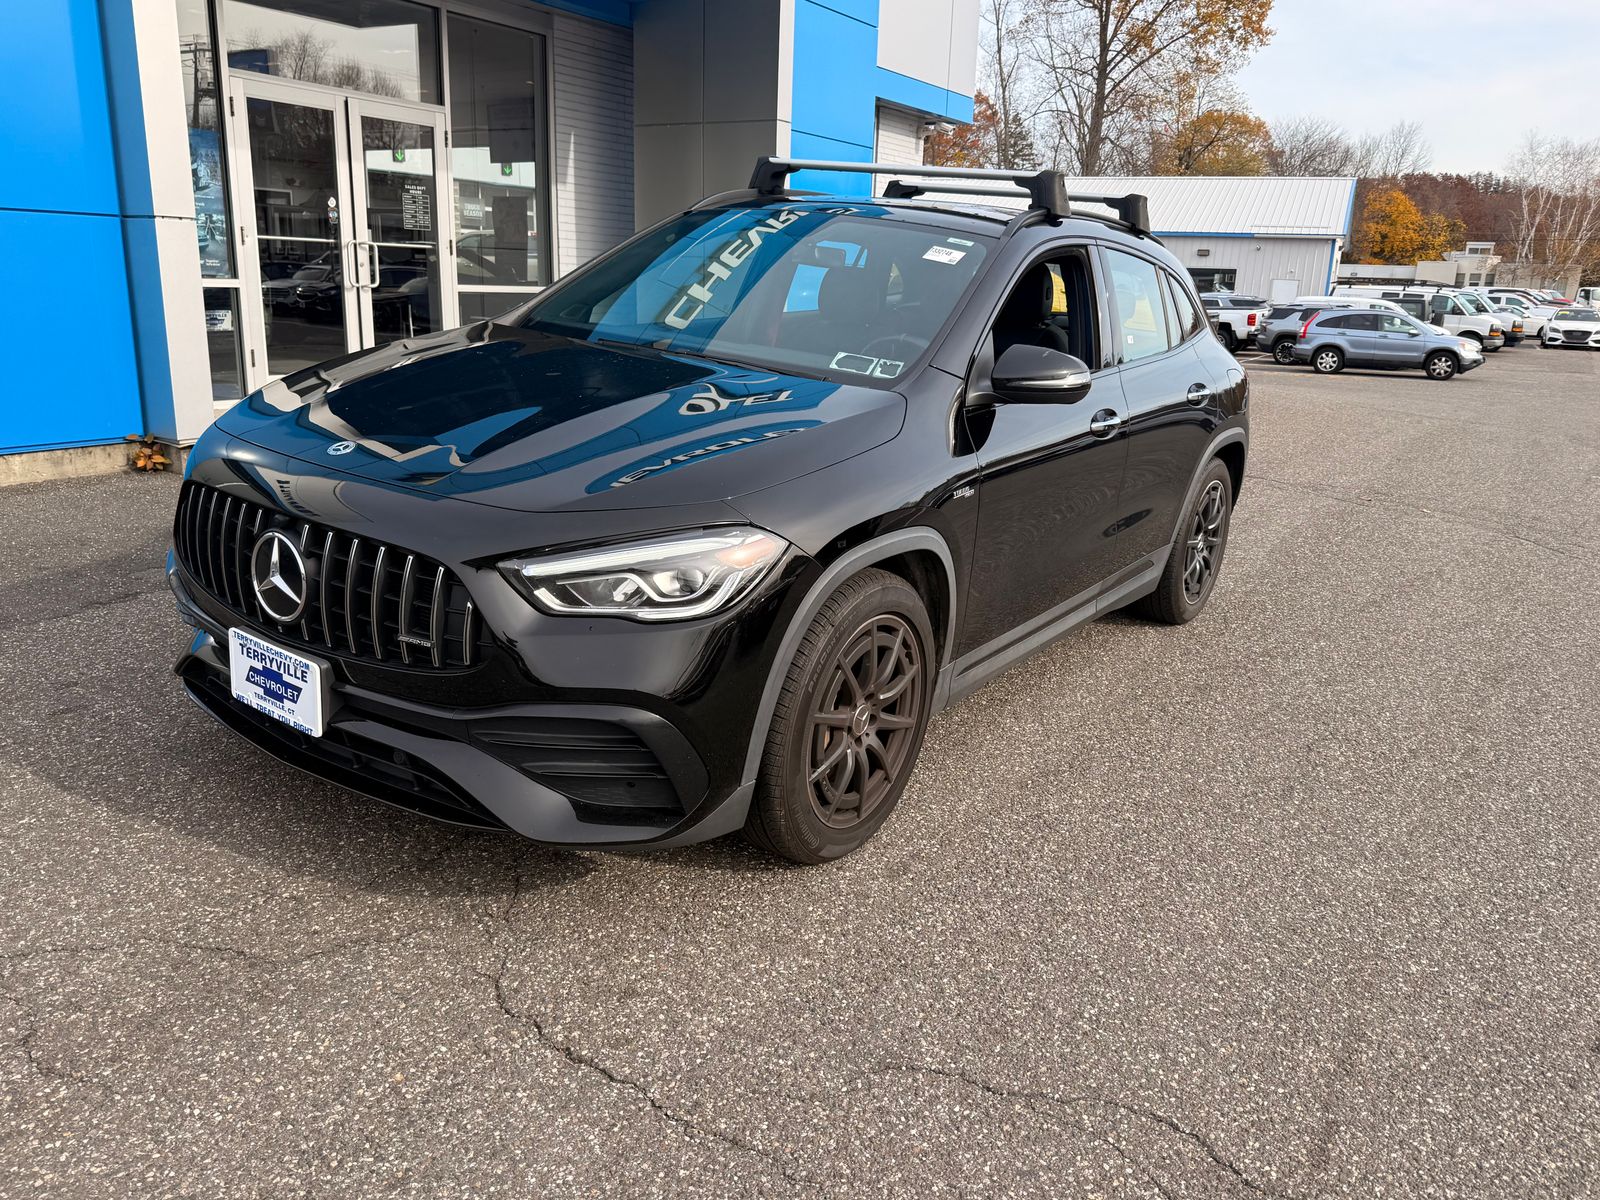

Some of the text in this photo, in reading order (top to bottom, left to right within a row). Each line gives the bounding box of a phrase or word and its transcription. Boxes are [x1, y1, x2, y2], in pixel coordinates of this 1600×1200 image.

[233, 630, 310, 671] TERRYVILLECHEVY.COM
[239, 643, 308, 684] TERRYVILLE
[249, 671, 299, 702] CHEVROLET
[255, 703, 275, 717] TREAT
[277, 714, 290, 726] YOU
[293, 721, 314, 736] RIGHT
[287, 707, 295, 715] CT
